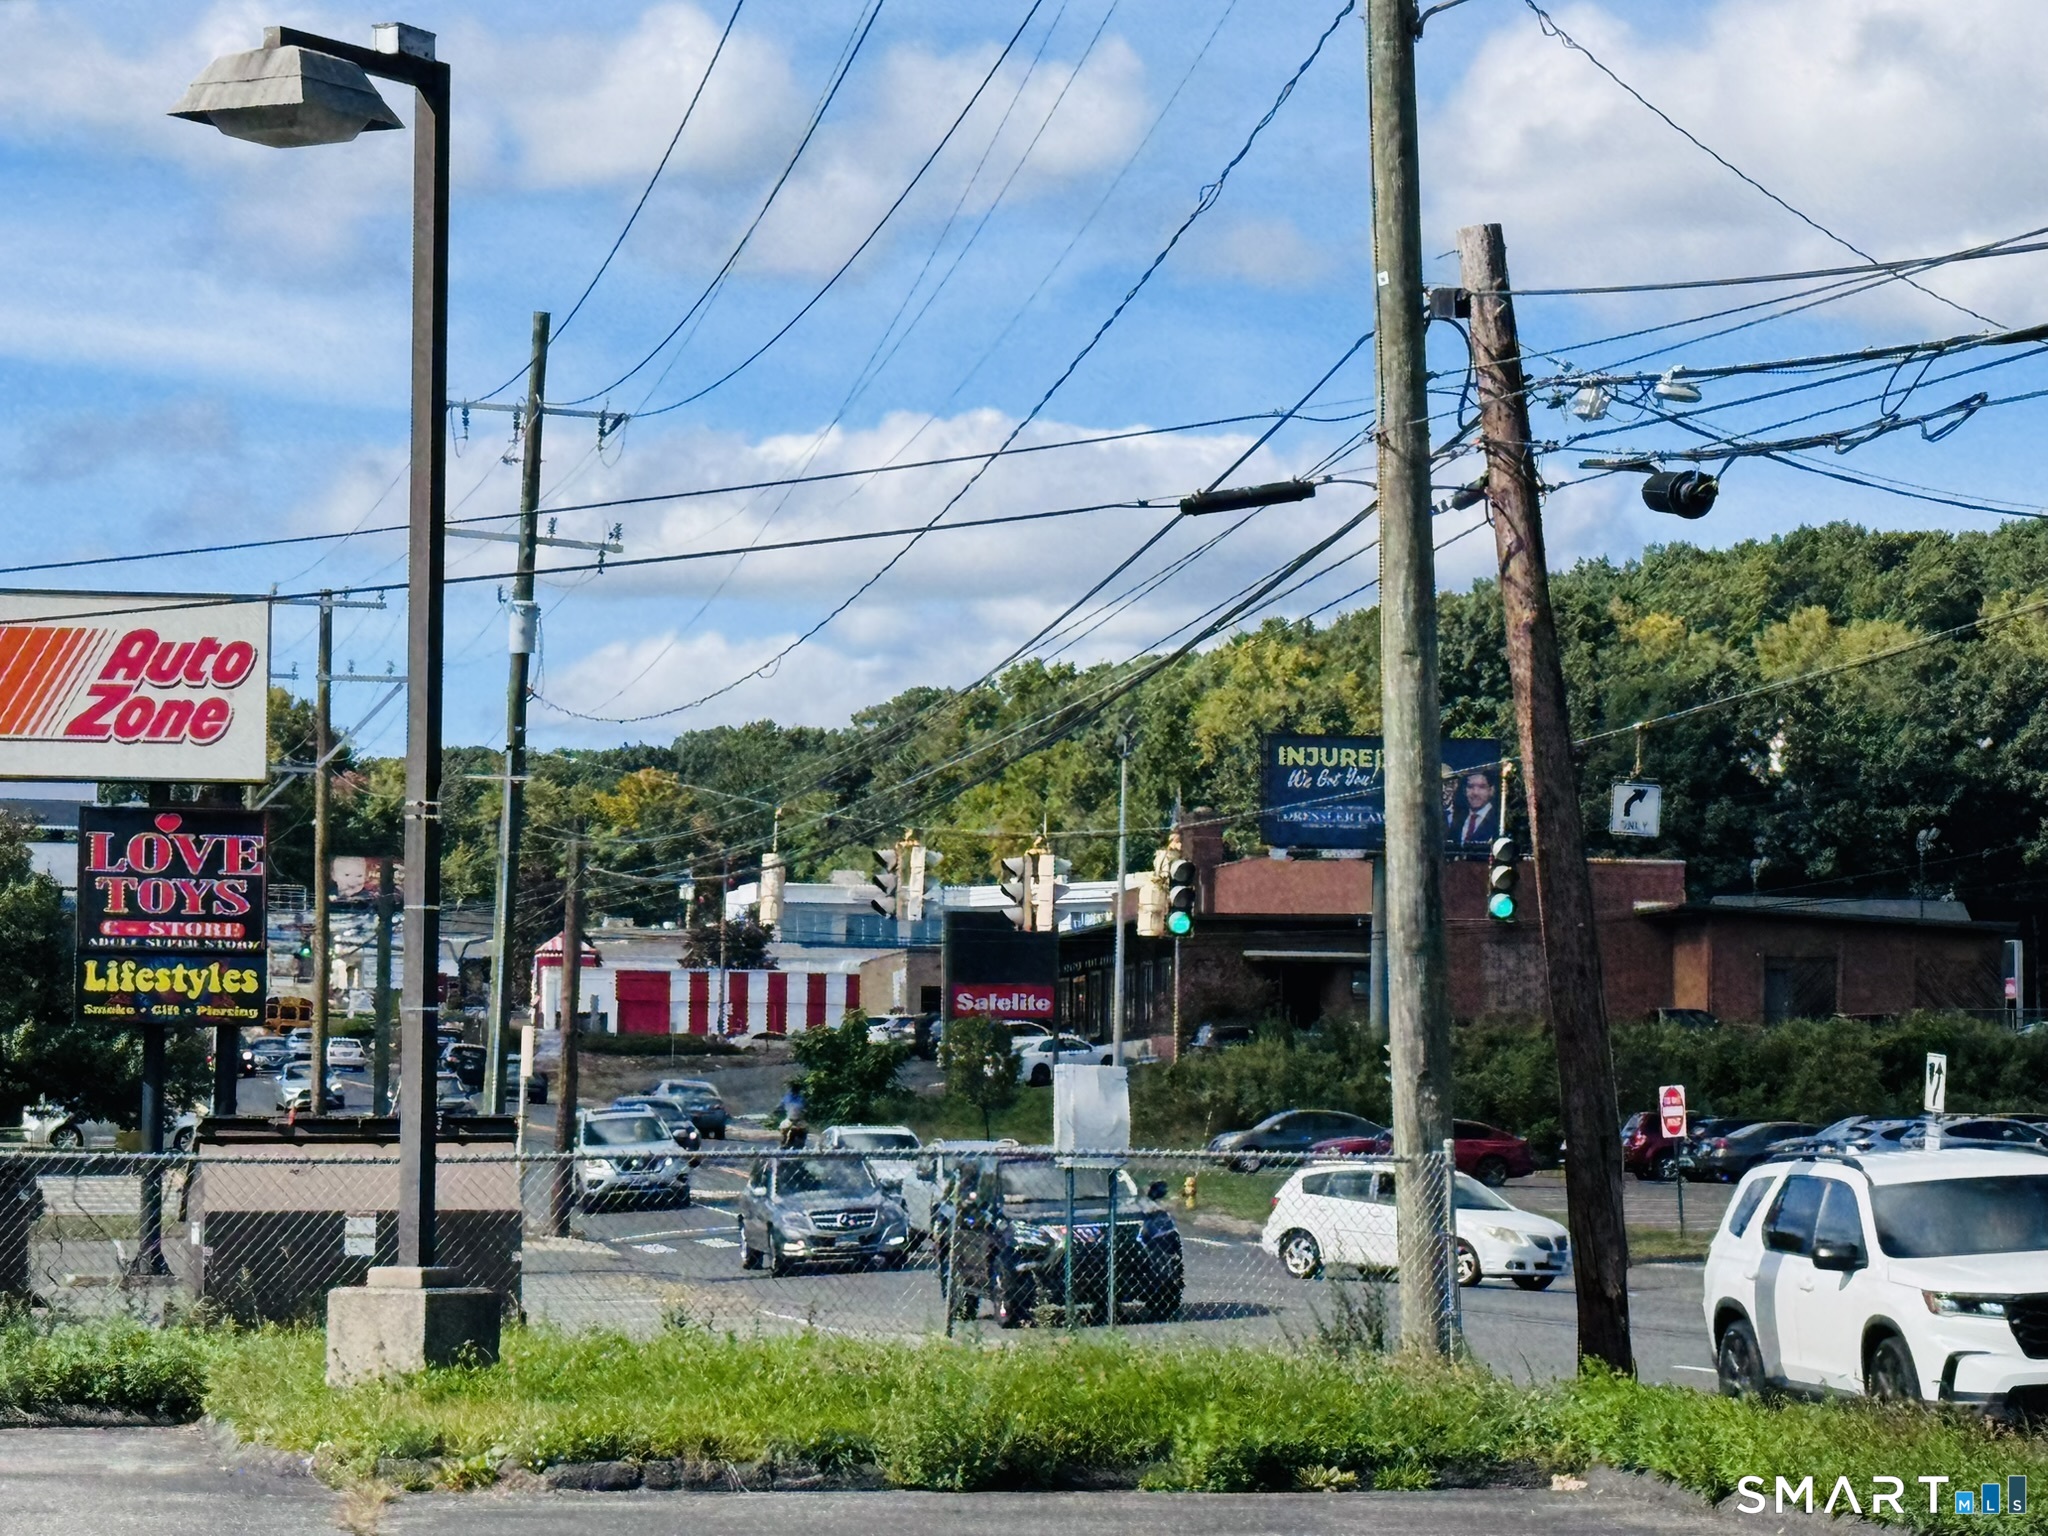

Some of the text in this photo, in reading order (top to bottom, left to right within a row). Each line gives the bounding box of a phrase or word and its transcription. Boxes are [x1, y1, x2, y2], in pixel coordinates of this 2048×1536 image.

[98, 628, 257, 689] Auto
[63, 684, 234, 746] Zone
[1288, 768, 1312, 788] We
[1620, 820, 1648, 830] NLY
[85, 832, 264, 876] LOVE
[95, 877, 250, 915] TOYS
[149, 922, 242, 937] STORE
[83, 960, 259, 1000] Lifestyles
[84, 1004, 136, 1015] Smoke
[956, 992, 1051, 1012] Safelite
